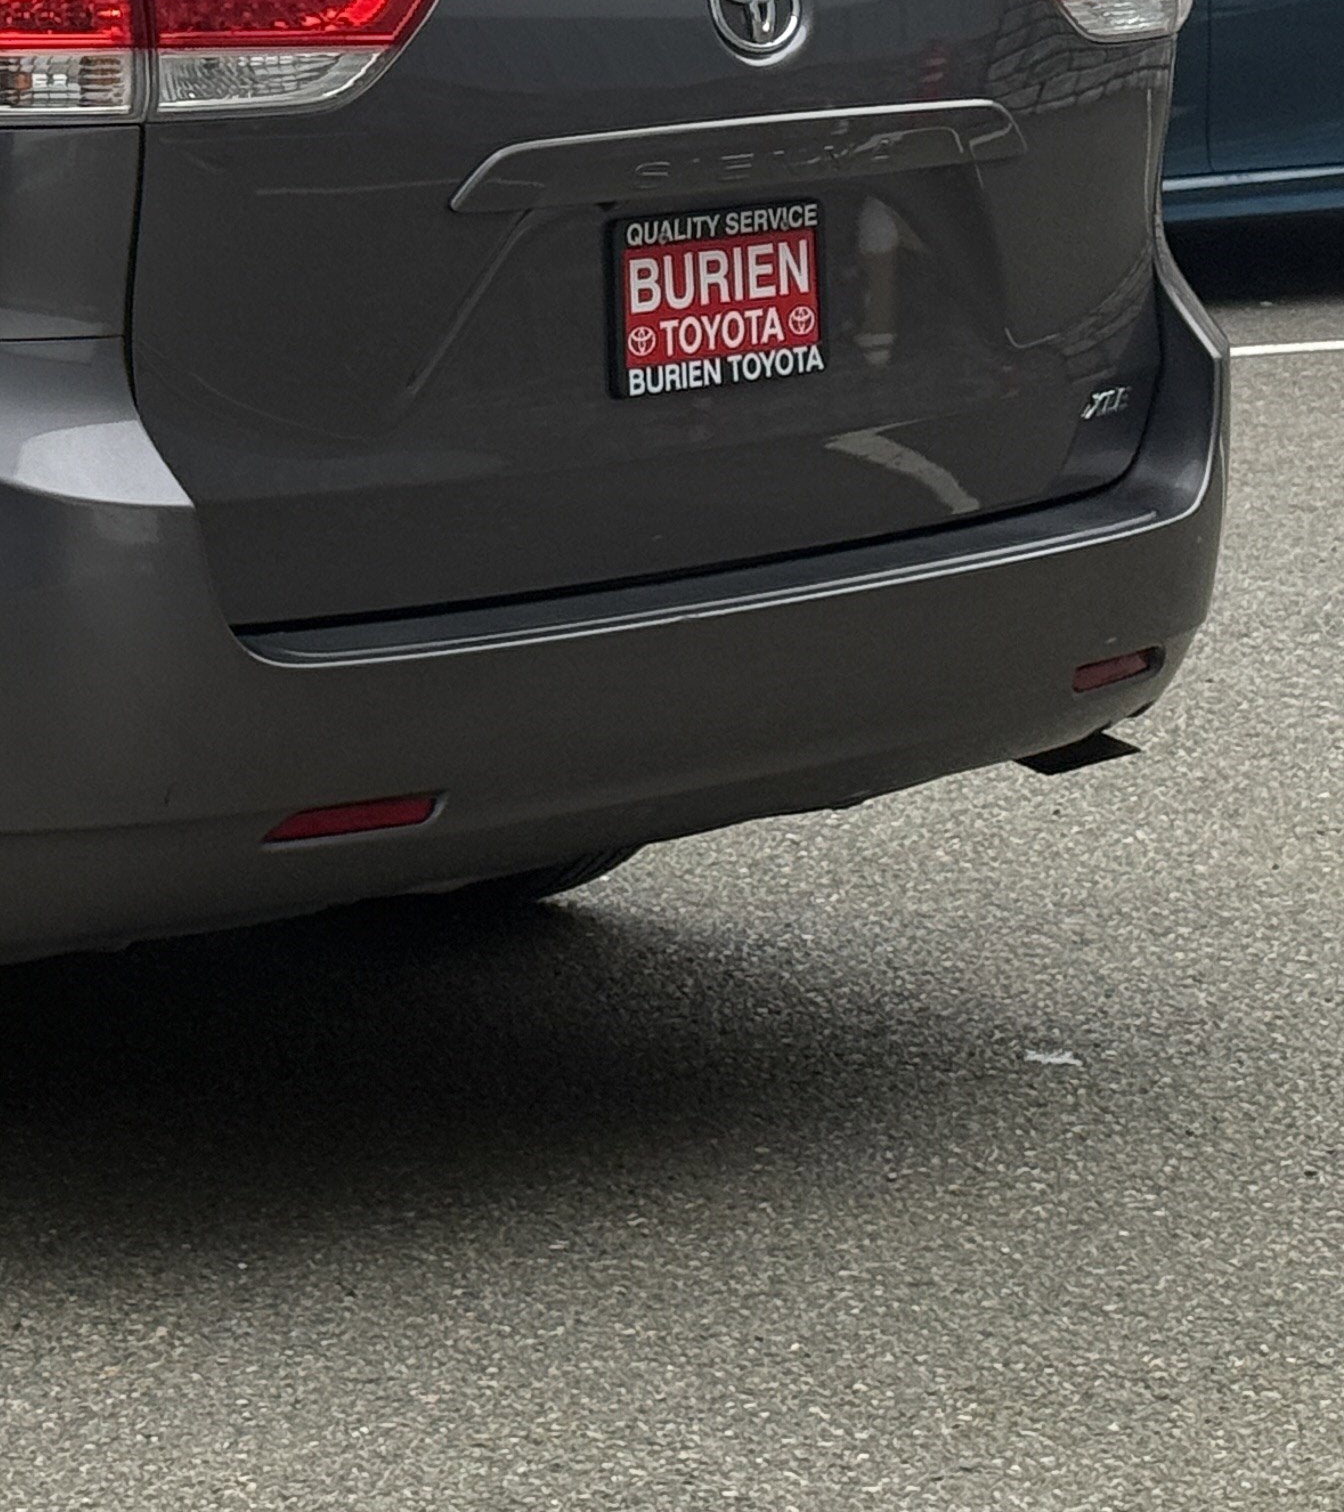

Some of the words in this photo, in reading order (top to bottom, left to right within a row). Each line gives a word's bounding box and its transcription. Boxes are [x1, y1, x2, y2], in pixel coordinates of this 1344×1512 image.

[626, 214, 721, 247] QUALITY
[725, 203, 819, 235] SERVICE
[628, 238, 811, 315] BURIEN
[659, 306, 785, 357] TOYOTA
[628, 355, 722, 397] BURIEN
[727, 345, 825, 383] TOYOTA
